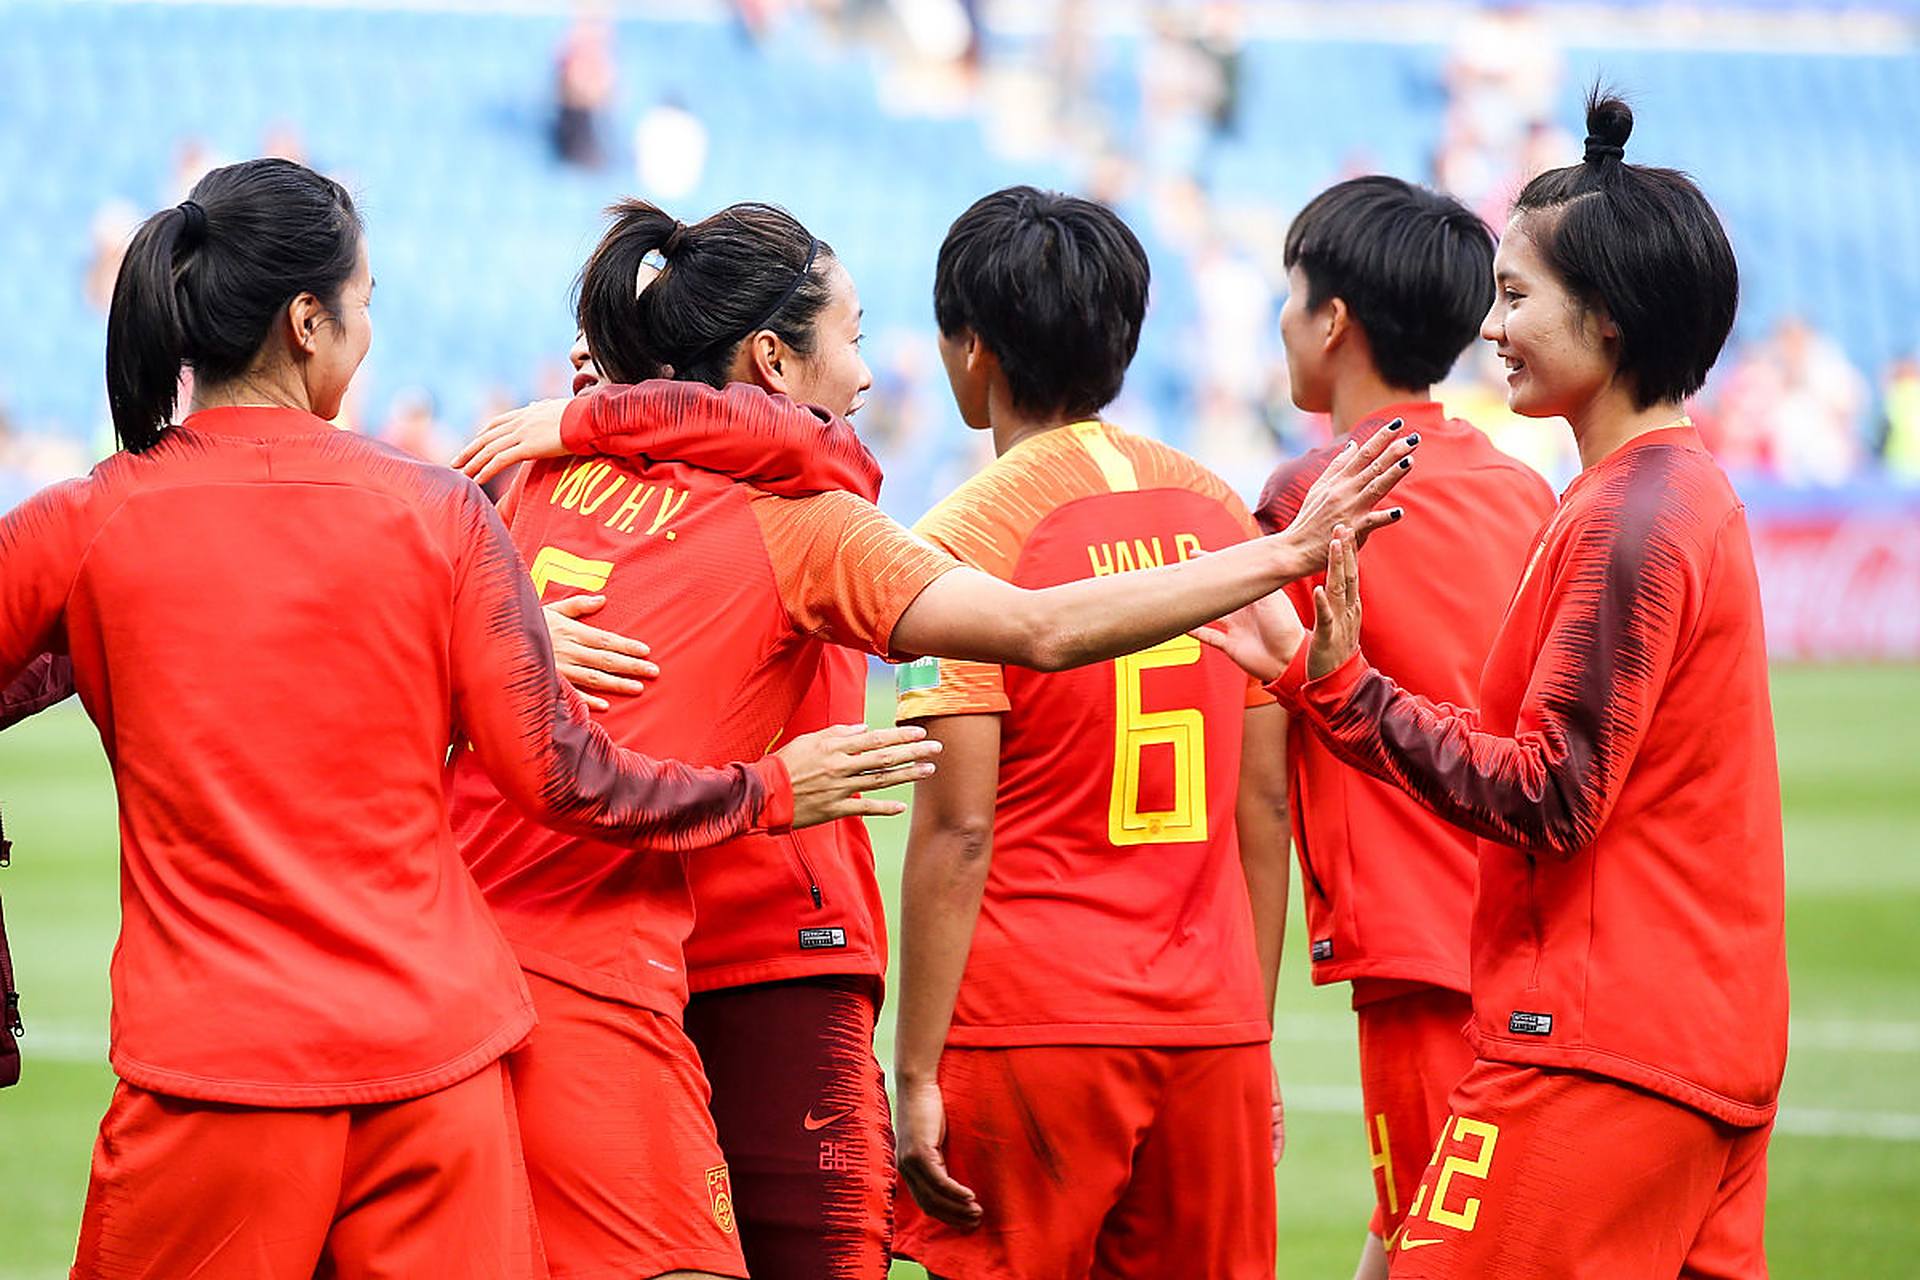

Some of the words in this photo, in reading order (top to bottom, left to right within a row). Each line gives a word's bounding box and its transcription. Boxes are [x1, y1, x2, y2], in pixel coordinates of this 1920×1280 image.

[604, 483, 688, 540] H.Y.
[1087, 537, 1164, 577] HAN
[1108, 634, 1207, 846] 6
